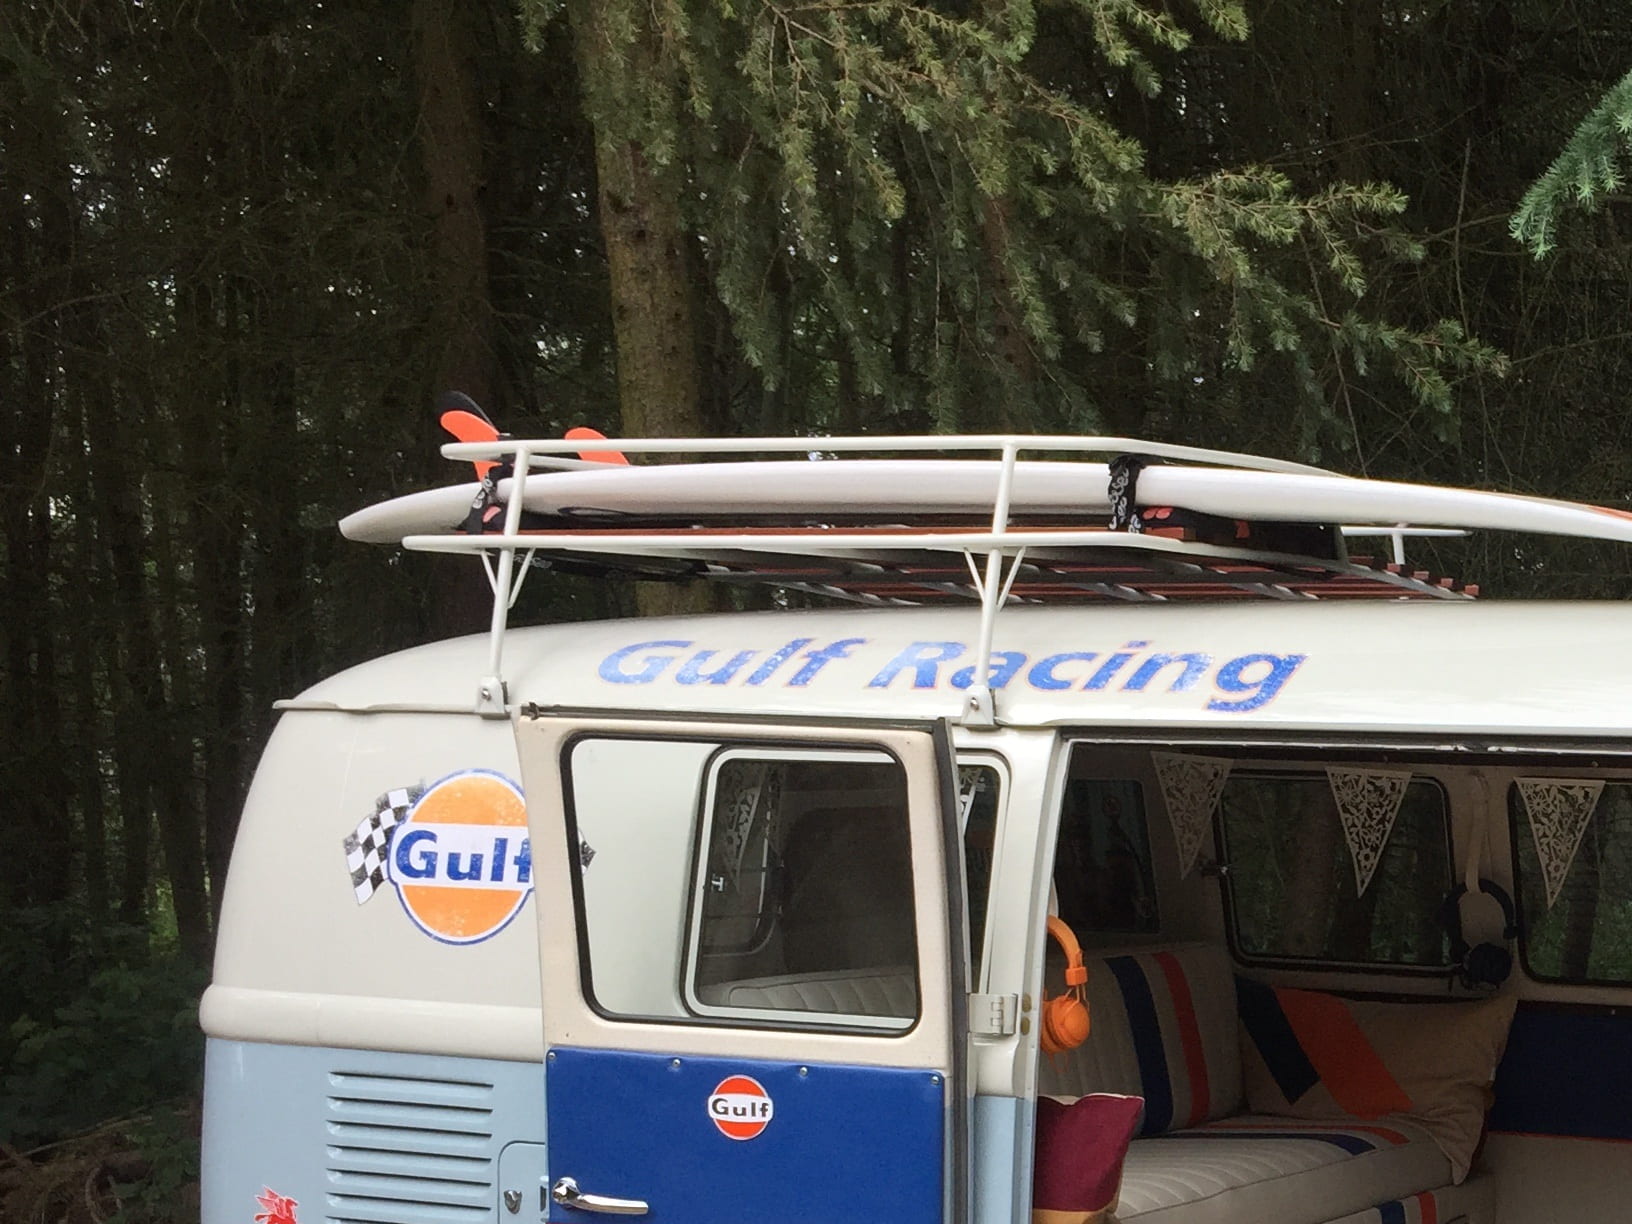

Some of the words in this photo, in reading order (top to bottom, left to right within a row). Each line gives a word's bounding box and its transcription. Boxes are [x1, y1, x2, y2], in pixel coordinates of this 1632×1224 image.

[598, 638, 872, 687] Gulf
[863, 640, 1310, 713] Racing
[396, 830, 532, 883] Gulf
[711, 1097, 769, 1117] Gulf
